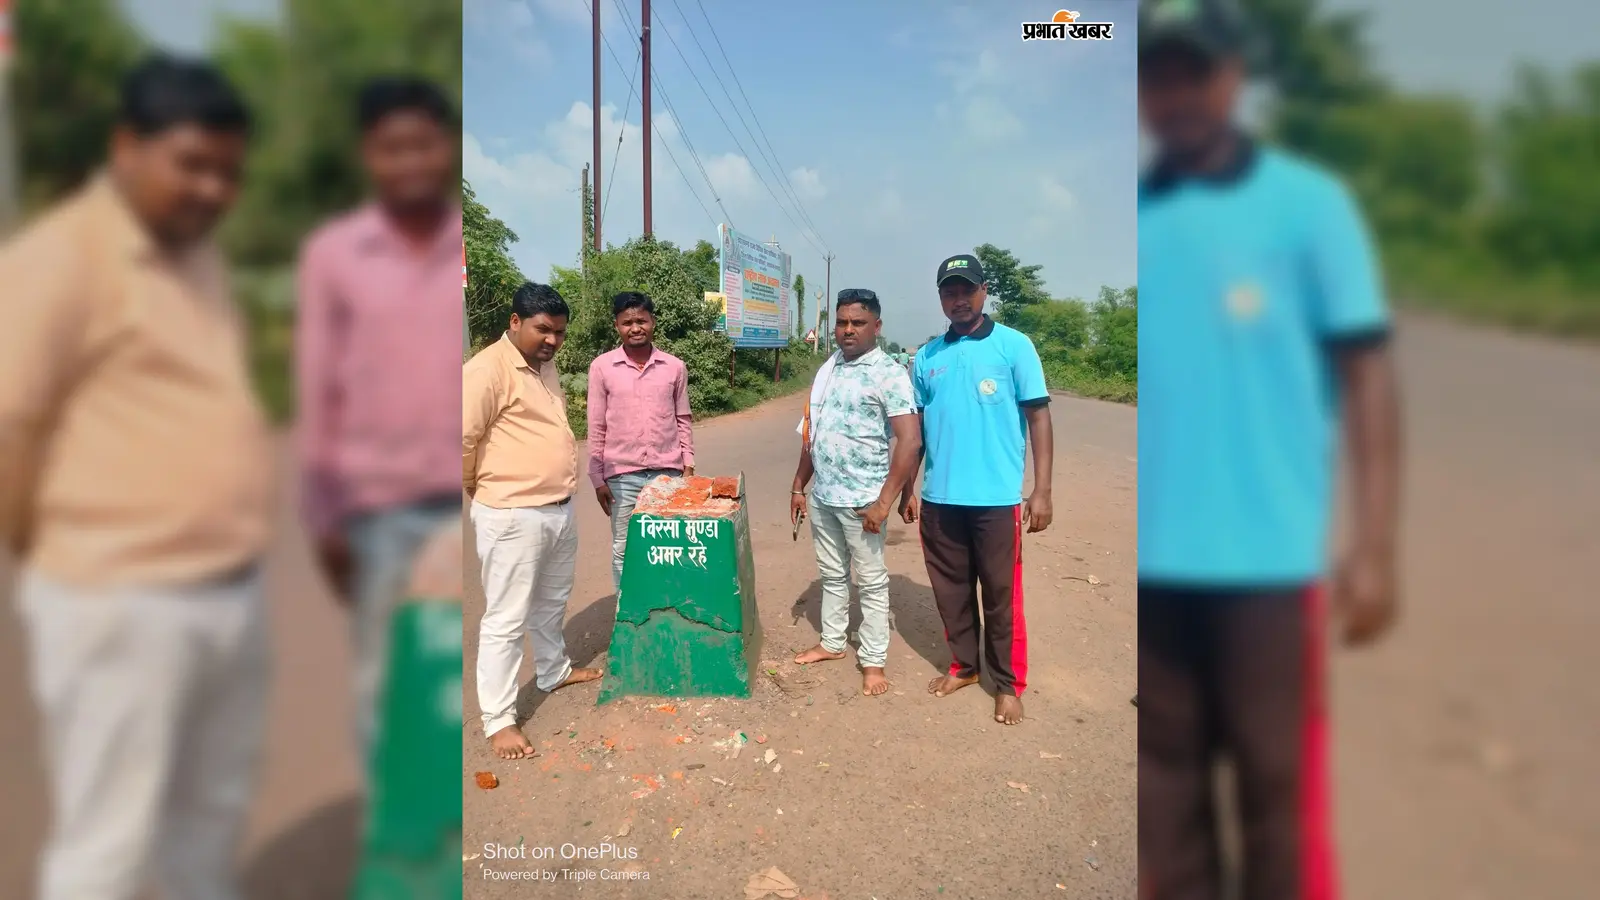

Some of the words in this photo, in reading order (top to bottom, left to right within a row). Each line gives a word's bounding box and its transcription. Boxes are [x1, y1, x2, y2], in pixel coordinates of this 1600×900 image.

[684, 519, 719, 544] मुण्डा
[647, 545, 684, 567] अमर
[688, 541, 708, 570] रहे
